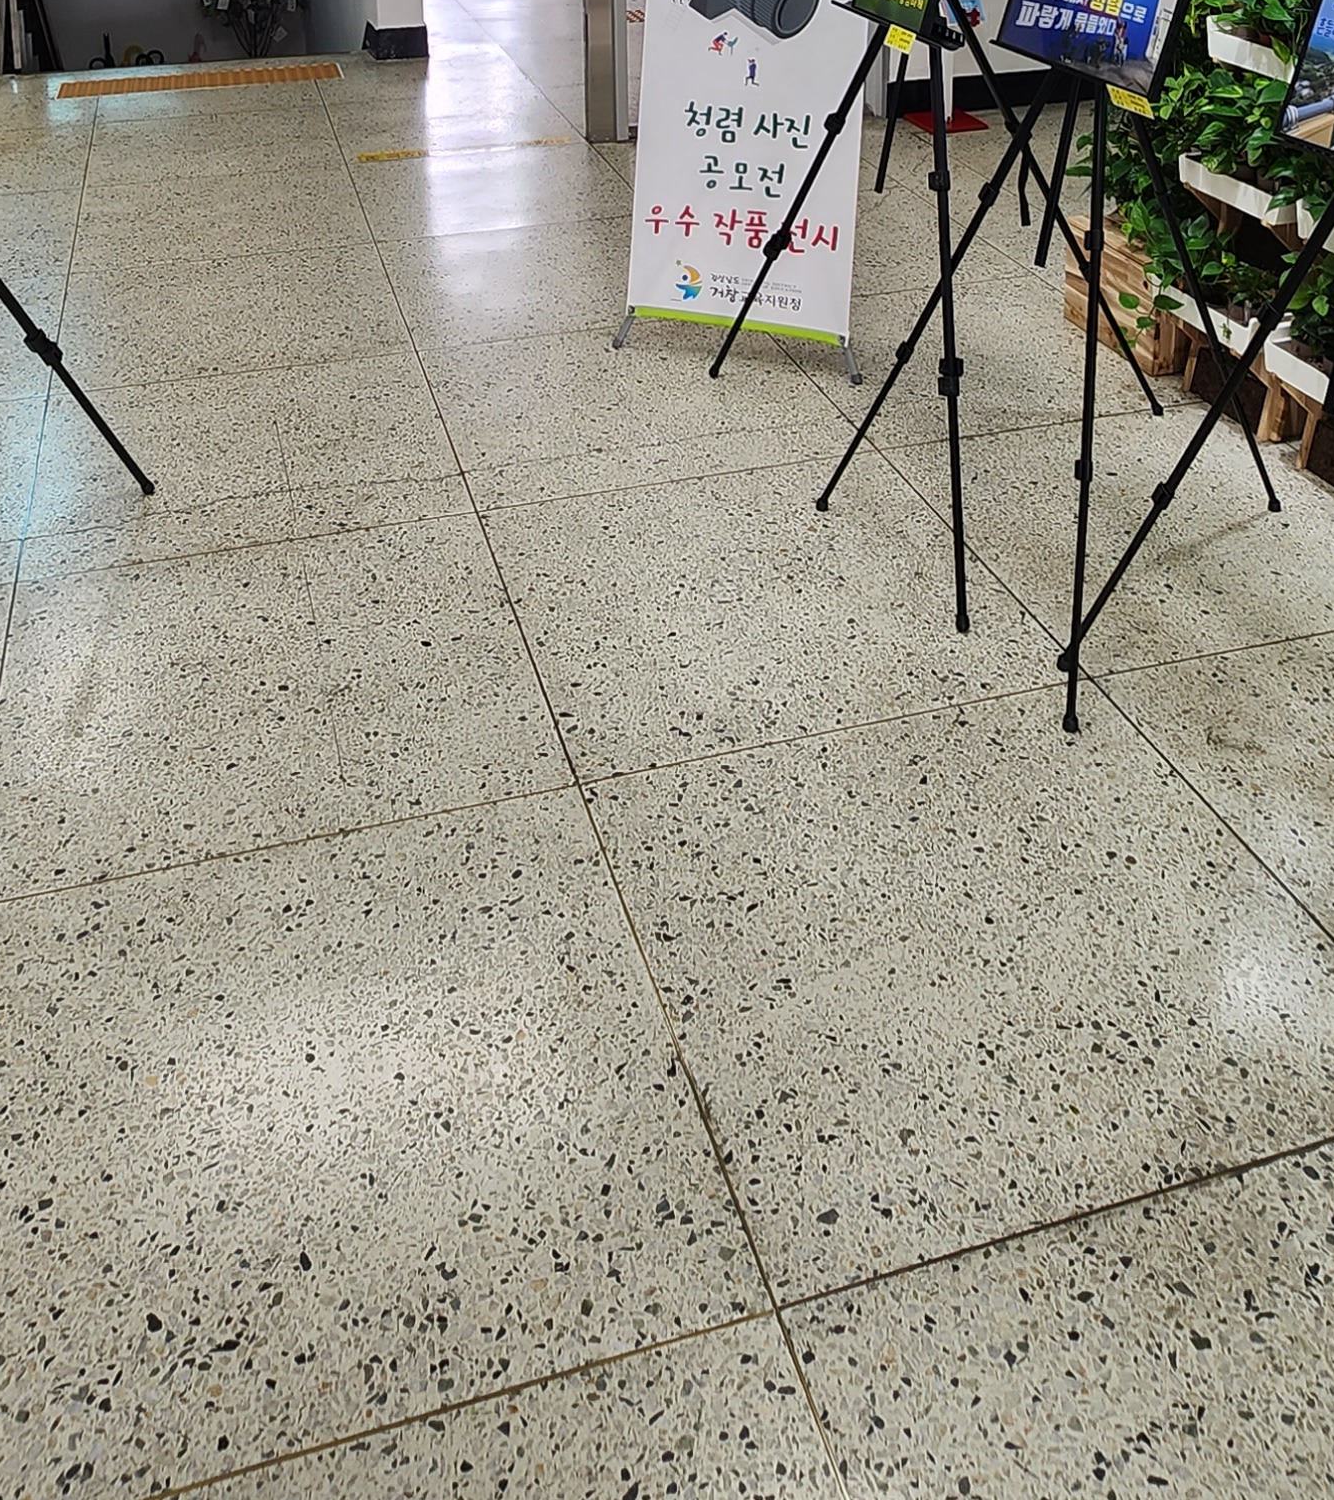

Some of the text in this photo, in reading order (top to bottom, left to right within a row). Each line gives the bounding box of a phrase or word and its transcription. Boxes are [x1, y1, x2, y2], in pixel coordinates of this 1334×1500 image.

[684, 101, 811, 149] 청렴 사진
[699, 155, 785, 198] 공모전
[645, 205, 700, 237] 우수
[713, 208, 768, 249] 작품
